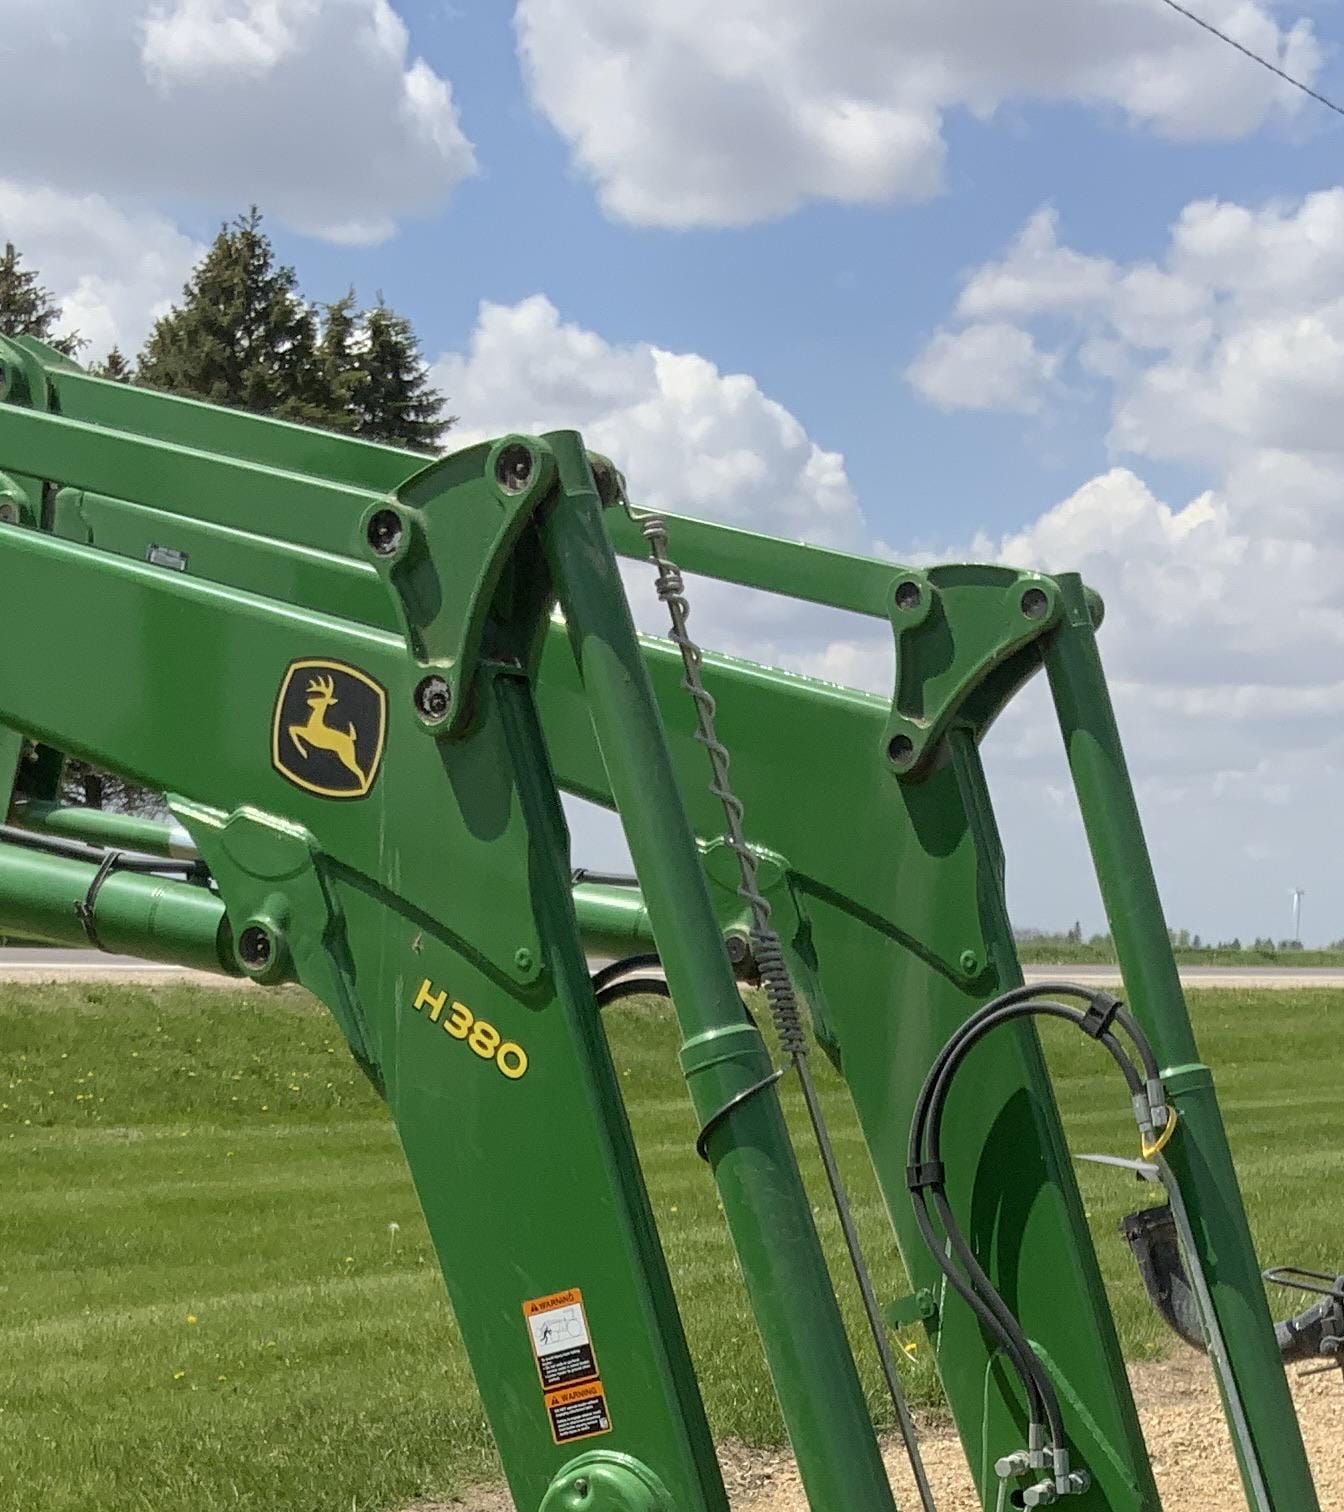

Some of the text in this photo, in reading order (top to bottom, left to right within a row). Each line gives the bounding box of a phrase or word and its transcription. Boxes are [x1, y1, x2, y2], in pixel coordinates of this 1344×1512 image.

[412, 978, 529, 1080] H380
[538, 1292, 575, 1311] WARNING
[561, 1387, 598, 1402] WARNING
